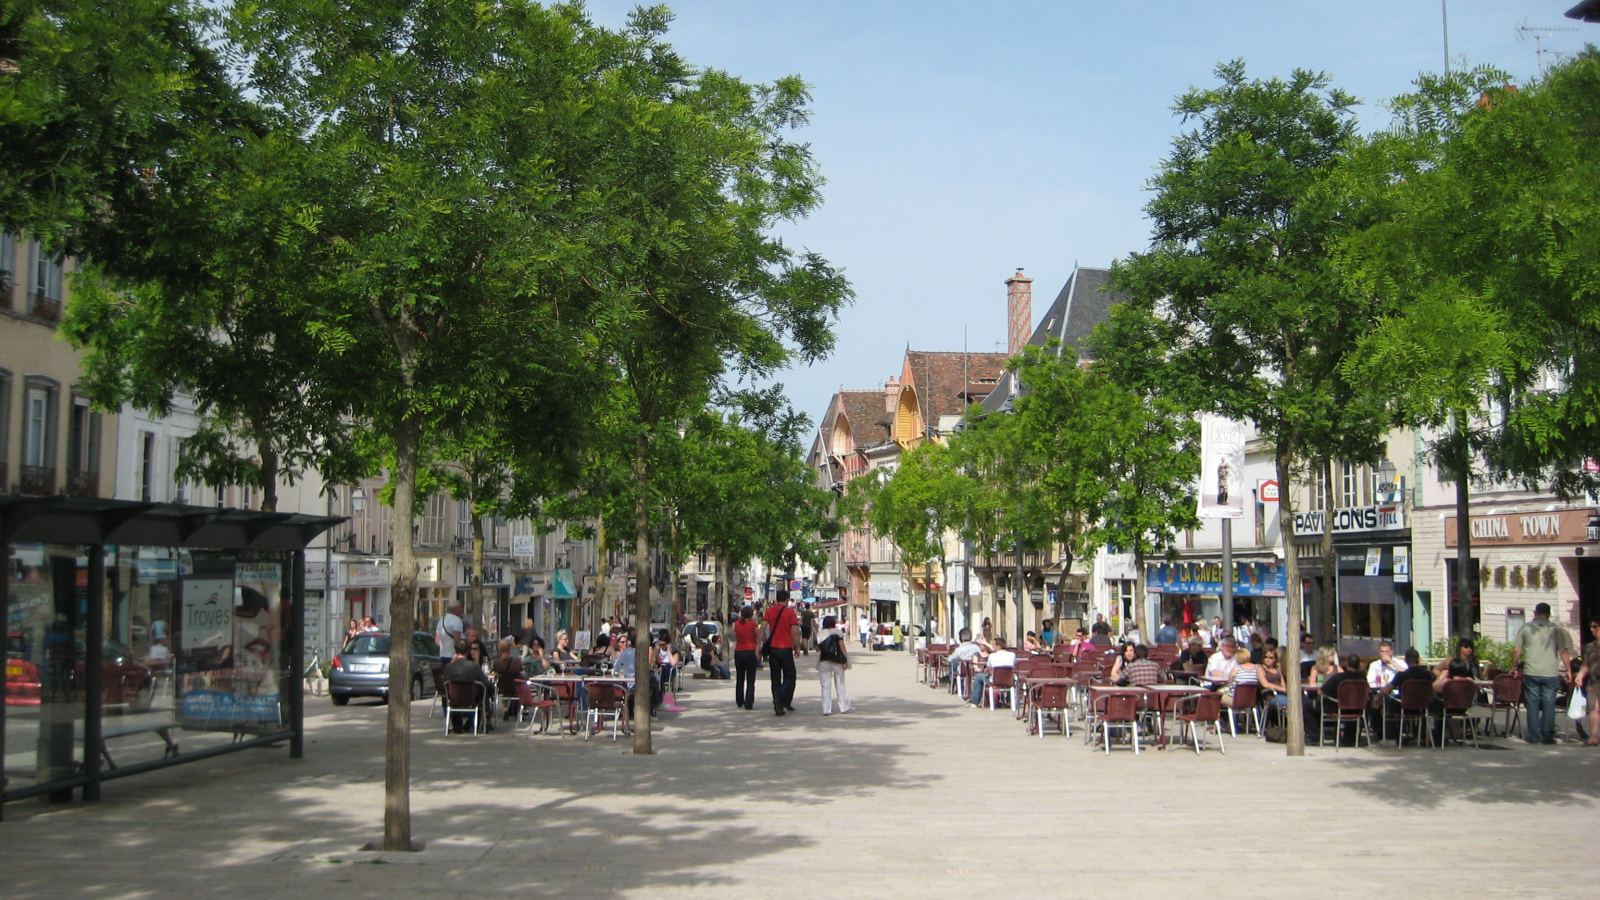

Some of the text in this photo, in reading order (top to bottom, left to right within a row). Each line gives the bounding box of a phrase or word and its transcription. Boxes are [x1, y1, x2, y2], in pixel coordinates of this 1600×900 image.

[1295, 507, 1377, 533] PAVILONS
[1471, 514, 1560, 538] CHINA TOWN
[1367, 556, 1378, 566] gan
[1393, 555, 1406, 566] gan
[463, 566, 504, 584] PHMACIE
[1180, 564, 1191, 582] LA
[1194, 564, 1239, 583] CAVERE
[186, 604, 230, 631] Troyes
